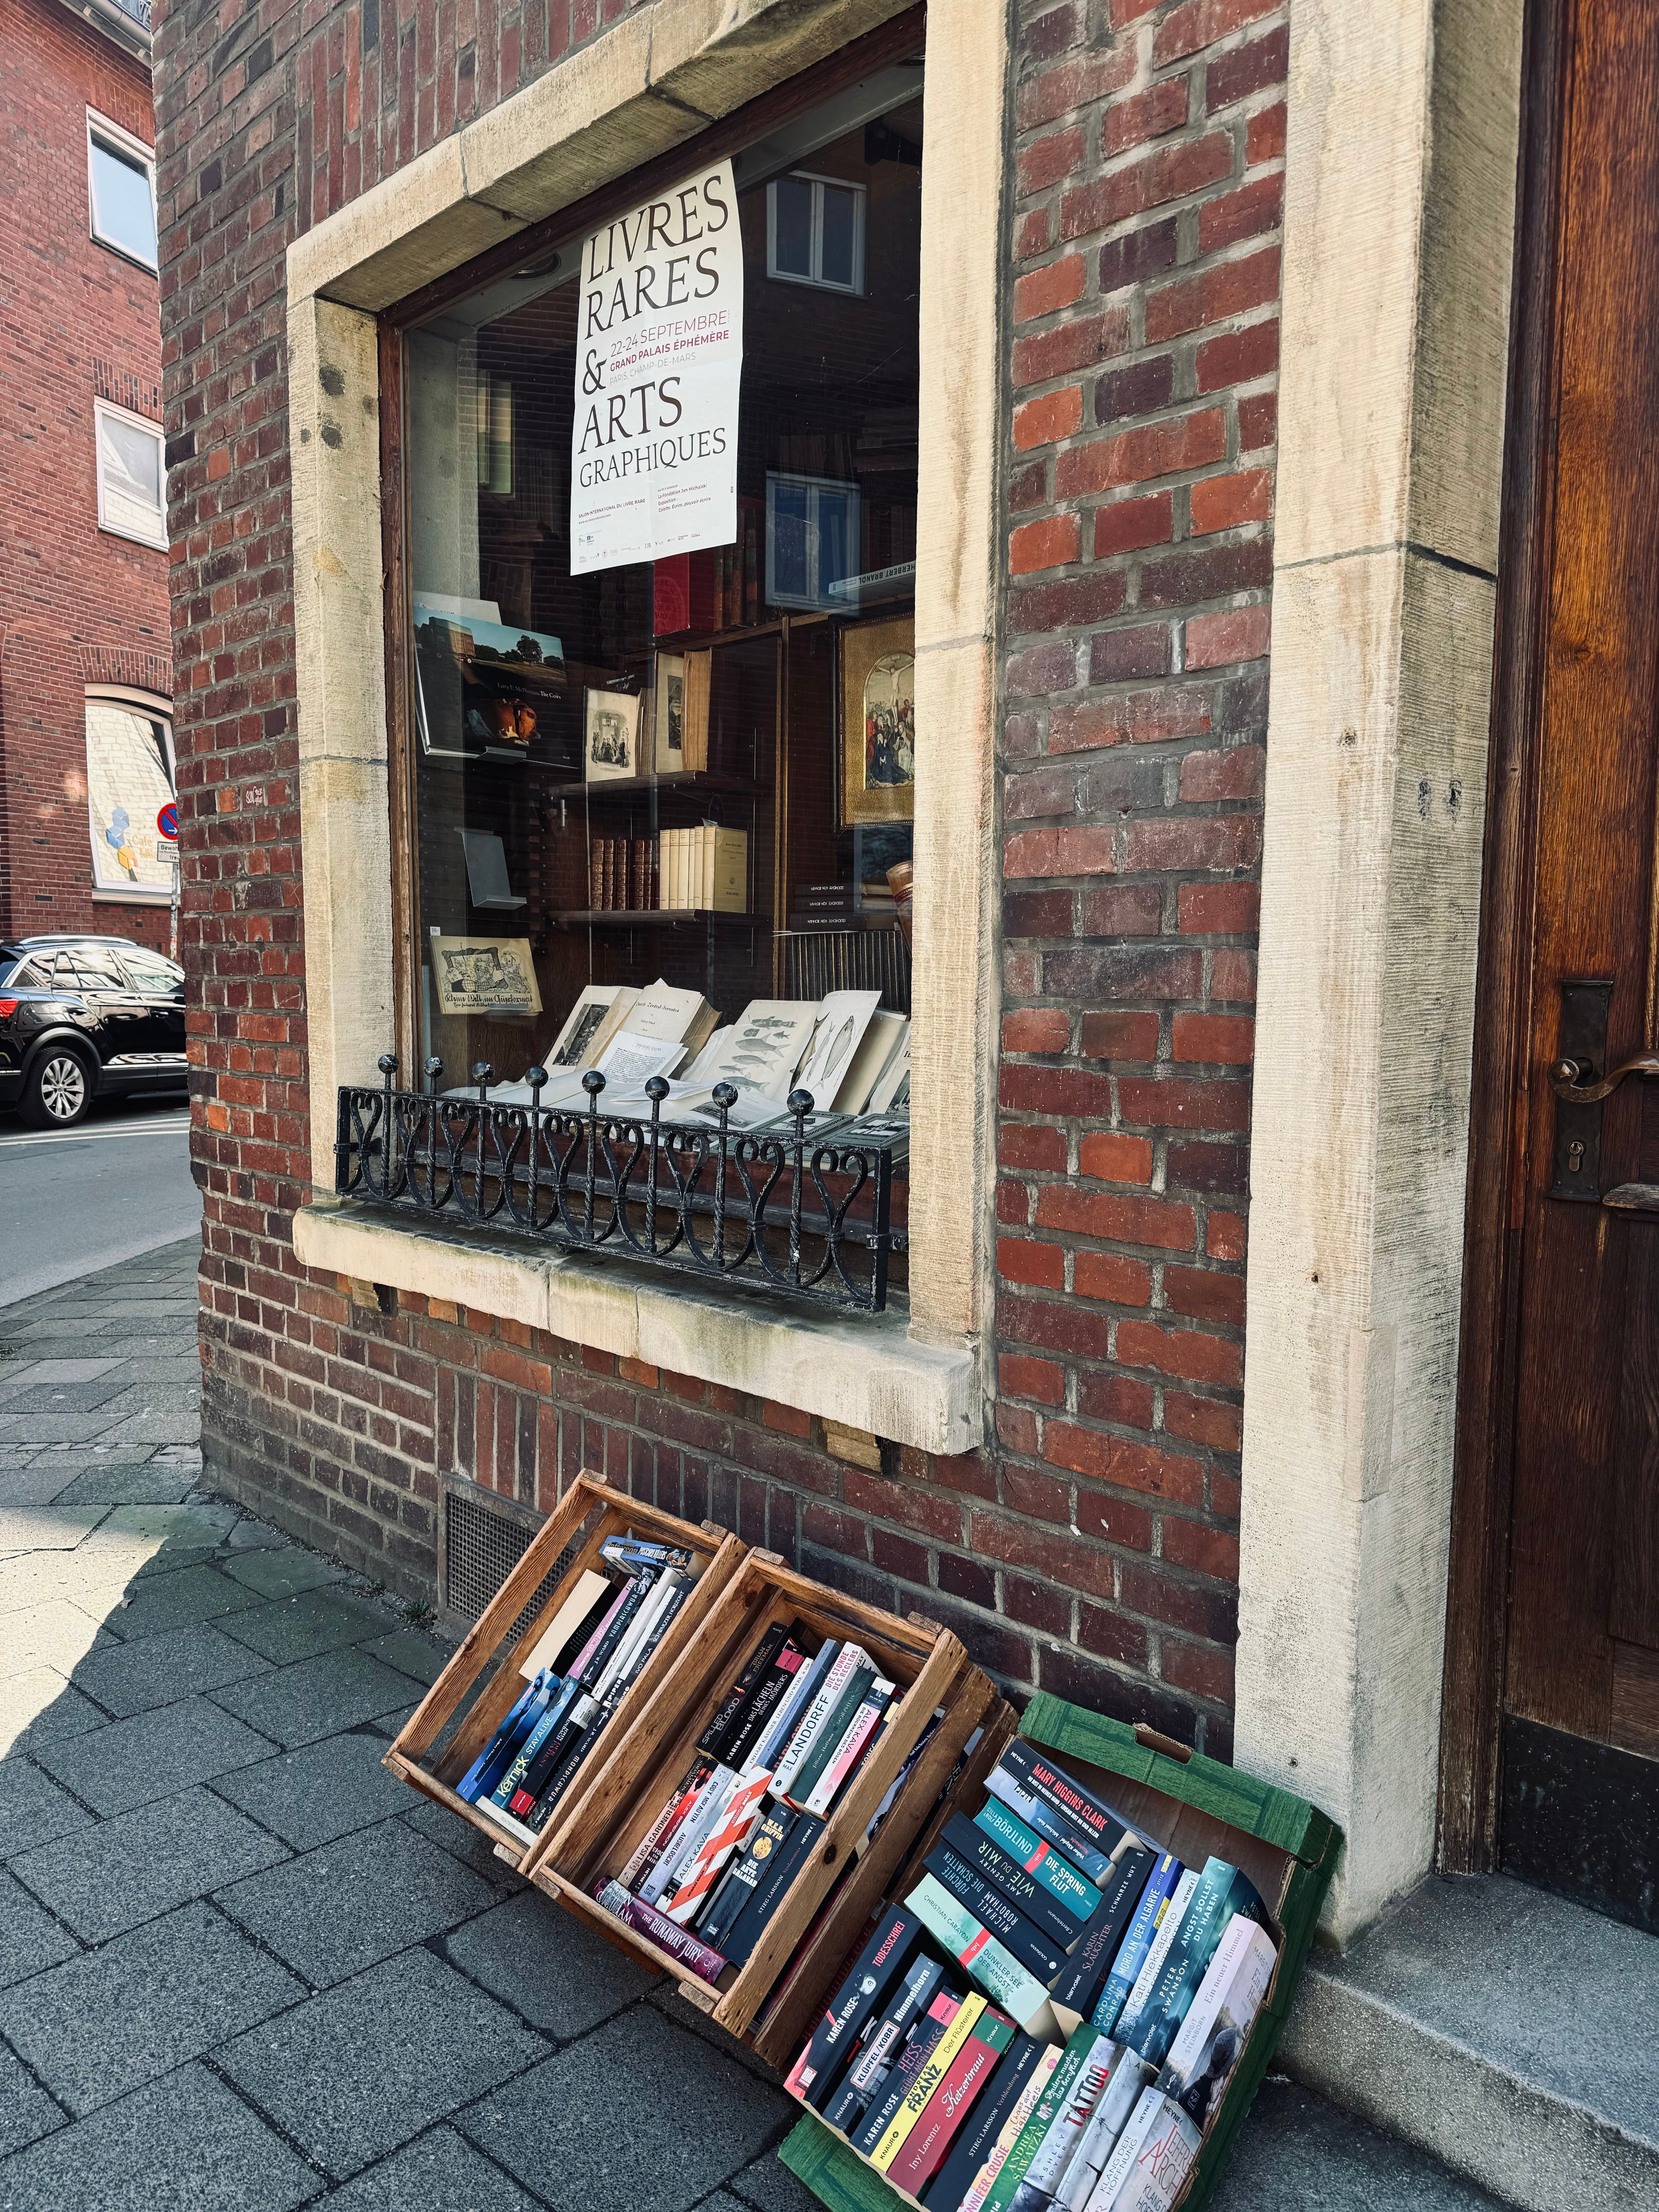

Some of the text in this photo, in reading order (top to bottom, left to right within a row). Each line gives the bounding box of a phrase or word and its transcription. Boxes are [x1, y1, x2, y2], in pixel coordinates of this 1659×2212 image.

[587, 175, 728, 284] LIVRES
[584, 247, 719, 340] RARES
[611, 310, 726, 357] 22-24 SEPTEMBRE
[582, 330, 729, 395] & GRAND PALAIS ÉPHÉMÈRE
[610, 352, 696, 385] PARIS, CHAMP-DE-MARS
[578, 377, 682, 454] ARTS
[580, 428, 726, 488] GRAPHIQUES
[589, 505, 616, 515] INTERNATIONAL
[859, 563, 915, 584] HERBERT BRANDL
[515, 686, 539, 696] McPherson
[445, 993, 465, 1002] Kleine
[467, 994, 483, 1002] Welt
[494, 993, 533, 1004] Querformat
[825, 1651, 849, 1688] DIE STUNDE
[833, 1650, 858, 1690] DES REGLERS
[716, 1698, 740, 1731] BLOOD
[758, 1700, 770, 1716] DEINES
[769, 1673, 788, 1701] MÖRDERS
[702, 1714, 723, 1744] SPILLED
[726, 1681, 775, 1760] KAREN ROSE DAS LÄCHELN
[749, 1676, 803, 1764] ERHART KÄSTNER LEBEN UND WERK
[782, 1763, 793, 1771] MAX
[790, 1694, 829, 1765] LANDORFF
[496, 1716, 553, 1798] Kernick STAY ALIVE
[987, 1807, 998, 1819] CILLA
[1011, 1751, 1108, 1831] HEYNE MARY HIGGINS CLARK
[1015, 1786, 1032, 1803] PIPER
[639, 1845, 651, 1863] LISA
[649, 1809, 672, 1843] GARDNER
[993, 1815, 1033, 1855] BÖRJLIND
[641, 1868, 651, 1883] HEYNE
[740, 1863, 757, 1878] AKTE
[747, 1859, 759, 1869] DIE
[758, 1898, 769, 1914] STIEG
[768, 1875, 784, 1898] LARSSON
[800, 1826, 814, 1844] HEYNE
[941, 1866, 970, 1894] FÜRCHTE
[943, 1851, 984, 1893] DIE SCHATTEN
[978, 1841, 1035, 1898] WIE DU MIR
[979, 1860, 1021, 1896] AMY GENTRY
[1045, 1855, 1086, 1896] DIE SPRING
[1049, 1874, 1070, 1894] FLUT
[984, 1891, 1018, 1926] ROBOTHAM
[1109, 1865, 1136, 1913] SCHWARZE WUT
[1183, 1884, 1193, 1903] HEYNE
[924, 1895, 970, 1942] CHRISTIAN CARAYON
[977, 1899, 1012, 1934] MICHAEL
[1117, 1887, 1161, 1976] MORD AN DER ALGARVE
[1181, 1879, 1214, 1948] ANGST SOLLST
[1193, 1893, 1219, 1942] DU HABEN
[642, 1913, 653, 1924] THE
[649, 1918, 685, 1949] RUNAWAY
[676, 1940, 705, 1963] JURY
[872, 1920, 905, 1967] TODESSCHREI
[1082, 1932, 1099, 1957] KARIN
[977, 1955, 1010, 1989] DER ANGST
[983, 1949, 1021, 1989] DUNKLER SEE
[1159, 1967, 1176, 1997] PETER
[1163, 1959, 1189, 2013] SWANSON
[1204, 1929, 1244, 2004] Ein neuer Himmel
[893, 1969, 931, 2022] Himmelhorn
[940, 2002, 953, 2020] Knaur.
[1093, 1978, 1118, 2027] CAROLINA
[1103, 1986, 1123, 2027] CONRAD
[826, 1997, 859, 2044] KAREN ROSE
[944, 2008, 974, 2054] Der Flüsterer
[986, 2024, 1000, 2042] Knaur.
[1186, 2015, 1206, 2054] STEINBORN
[898, 2040, 923, 2073] HEISS
[900, 2028, 946, 2094] GLÜHT MEIN HASS
[1056, 2057, 1080, 2099] das beruflich
[906, 2065, 931, 2103] ANDREAS
[907, 2064, 942, 2113] FRANZ
[1063, 2064, 1109, 2127] TATTOO
[864, 2093, 899, 2146] KAREN ROSE
[1010, 2101, 1023, 2124] Chaos
[908, 2123, 941, 2171] Iny Lorentz
[1008, 2125, 1037, 2172] ANDREA
[1012, 2124, 1046, 2182] SAWATZKI
[1039, 2134, 1065, 2180] ASHLEY
[1100, 2136, 1131, 2192] KLANG DER
[1106, 2139, 1137, 2195] HOFFNUNG
